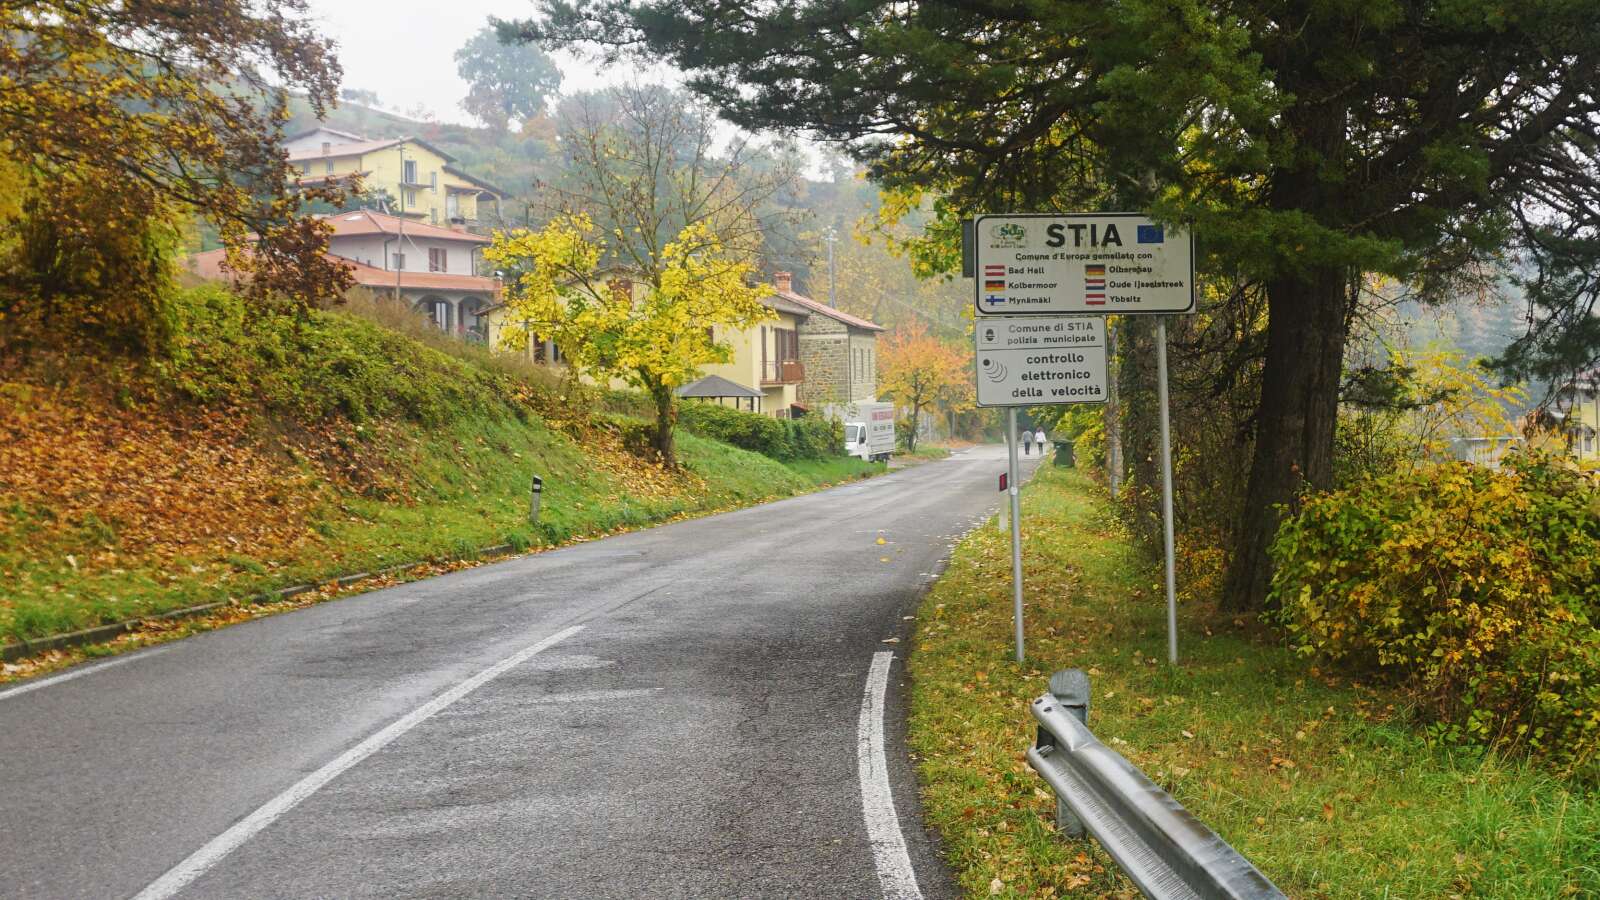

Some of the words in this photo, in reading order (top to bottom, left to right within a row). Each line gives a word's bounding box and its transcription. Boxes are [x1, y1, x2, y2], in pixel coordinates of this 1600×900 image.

[1046, 223, 1122, 247] STIA
[1016, 253, 1049, 261] Comune
[1052, 252, 1090, 261] d'Europa
[1092, 252, 1135, 261] gemellato
[1109, 280, 1131, 288] Oude
[1008, 296, 1051, 305] Mynämäki
[1110, 295, 1141, 303] Ybbsitz
[1008, 324, 1051, 333] Comune
[1054, 323, 1064, 331] di
[1068, 322, 1093, 331] STIA
[1008, 336, 1037, 345] polizia
[1044, 334, 1096, 343] municipale
[1027, 354, 1084, 364] controllo
[1022, 370, 1090, 380] elettronico
[1012, 388, 1042, 398] della
[1051, 385, 1101, 396] velocità
